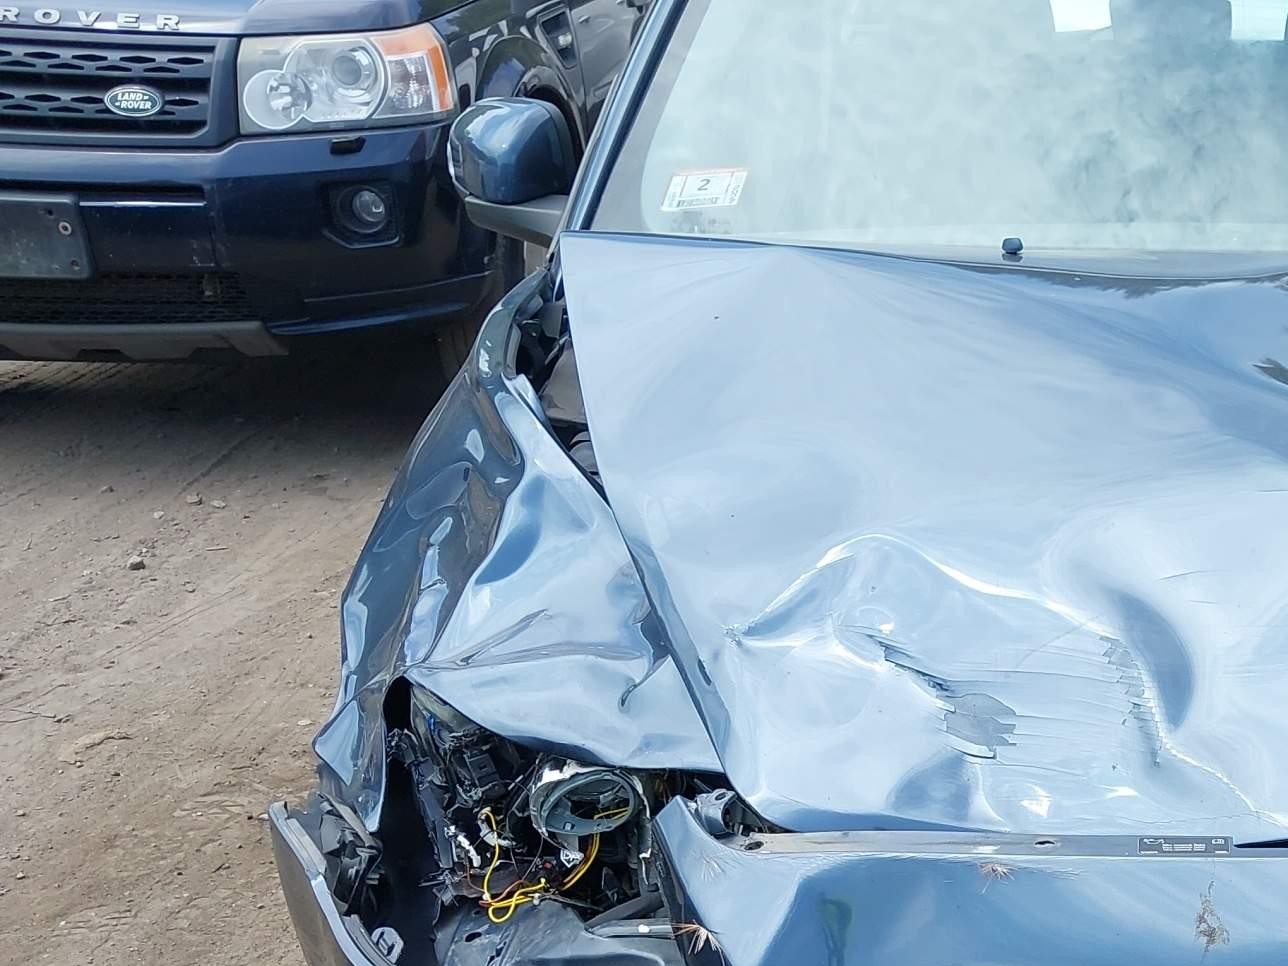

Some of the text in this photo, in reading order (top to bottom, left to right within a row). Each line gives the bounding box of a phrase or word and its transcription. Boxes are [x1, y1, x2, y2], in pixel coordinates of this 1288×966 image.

[0, 6, 180, 30] ROVER
[117, 92, 143, 101] LAND
[120, 101, 152, 109] ROVER
[697, 178, 711, 191] 2
